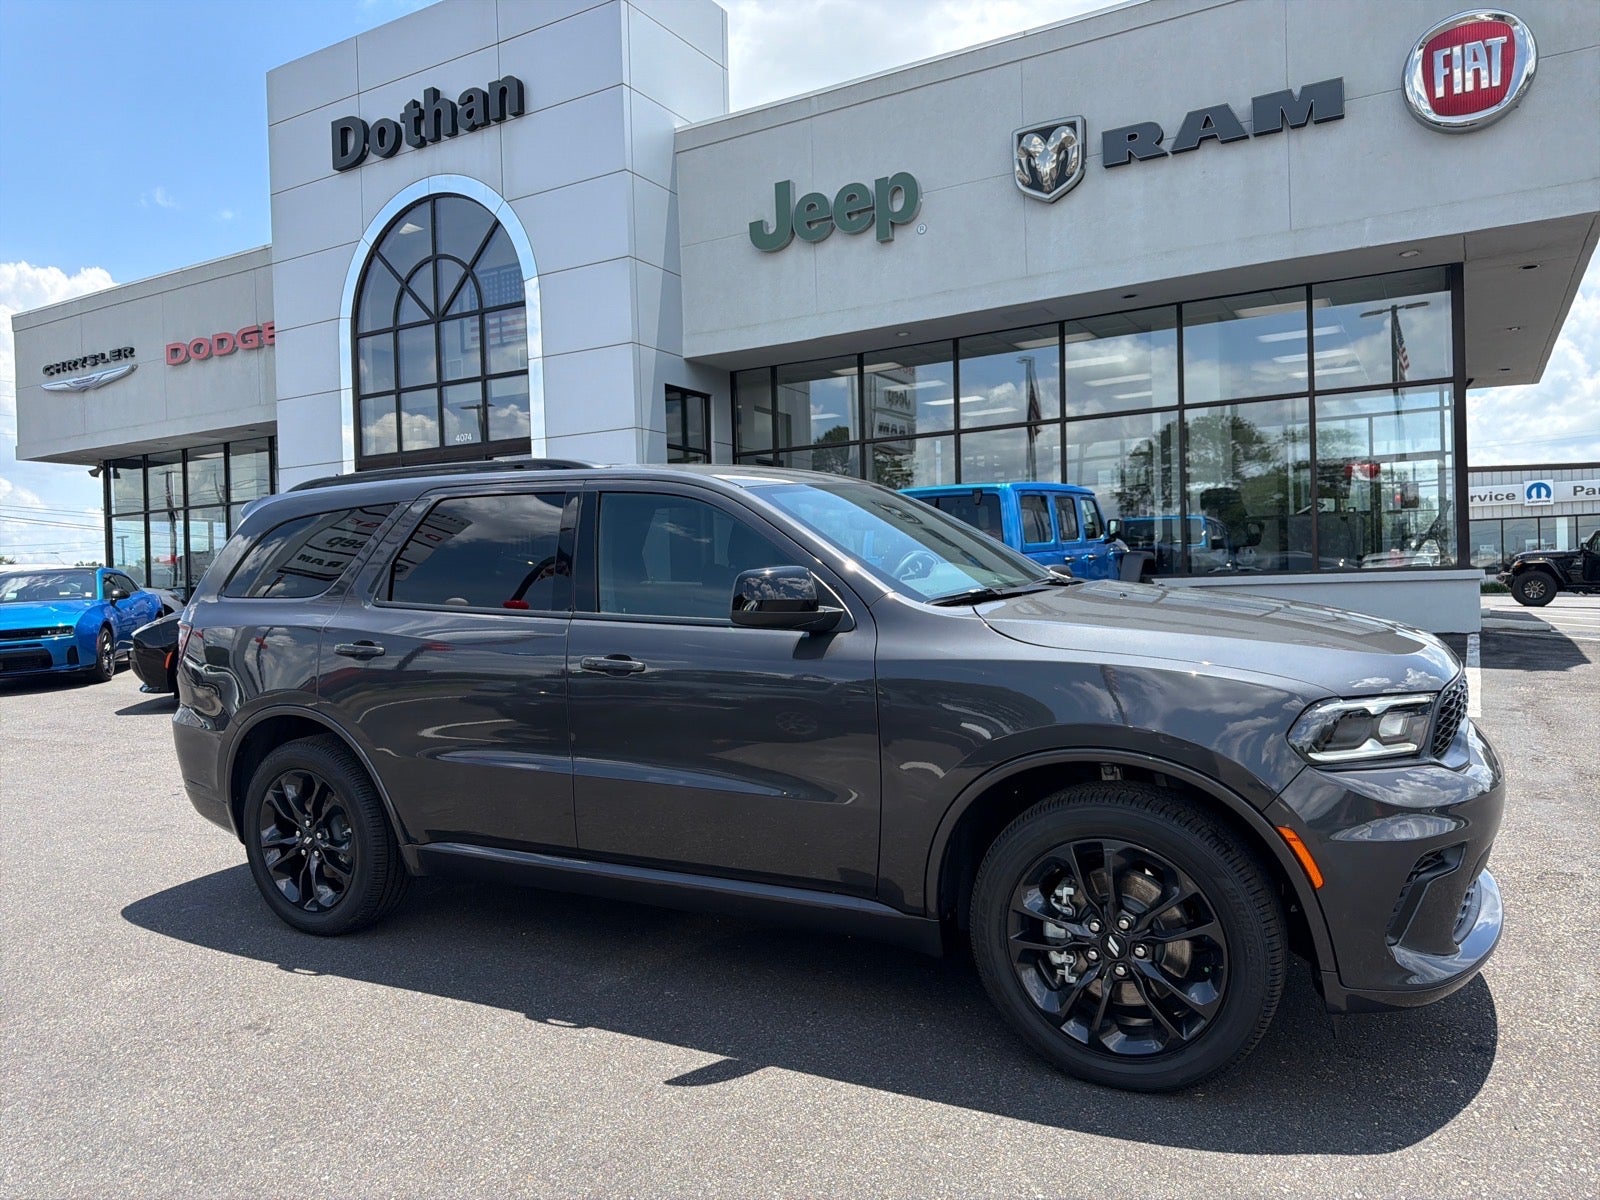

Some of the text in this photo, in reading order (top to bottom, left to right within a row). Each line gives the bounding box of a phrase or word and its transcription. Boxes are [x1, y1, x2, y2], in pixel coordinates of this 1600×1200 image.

[1432, 36, 1508, 100] FIAT
[331, 75, 525, 171] Dothan
[1101, 77, 1345, 169] RAM
[749, 171, 922, 252] Jeep
[42, 346, 136, 376] CHRYSLER
[455, 432, 472, 442] 4074
[1470, 485, 1600, 502] rvice Pa
